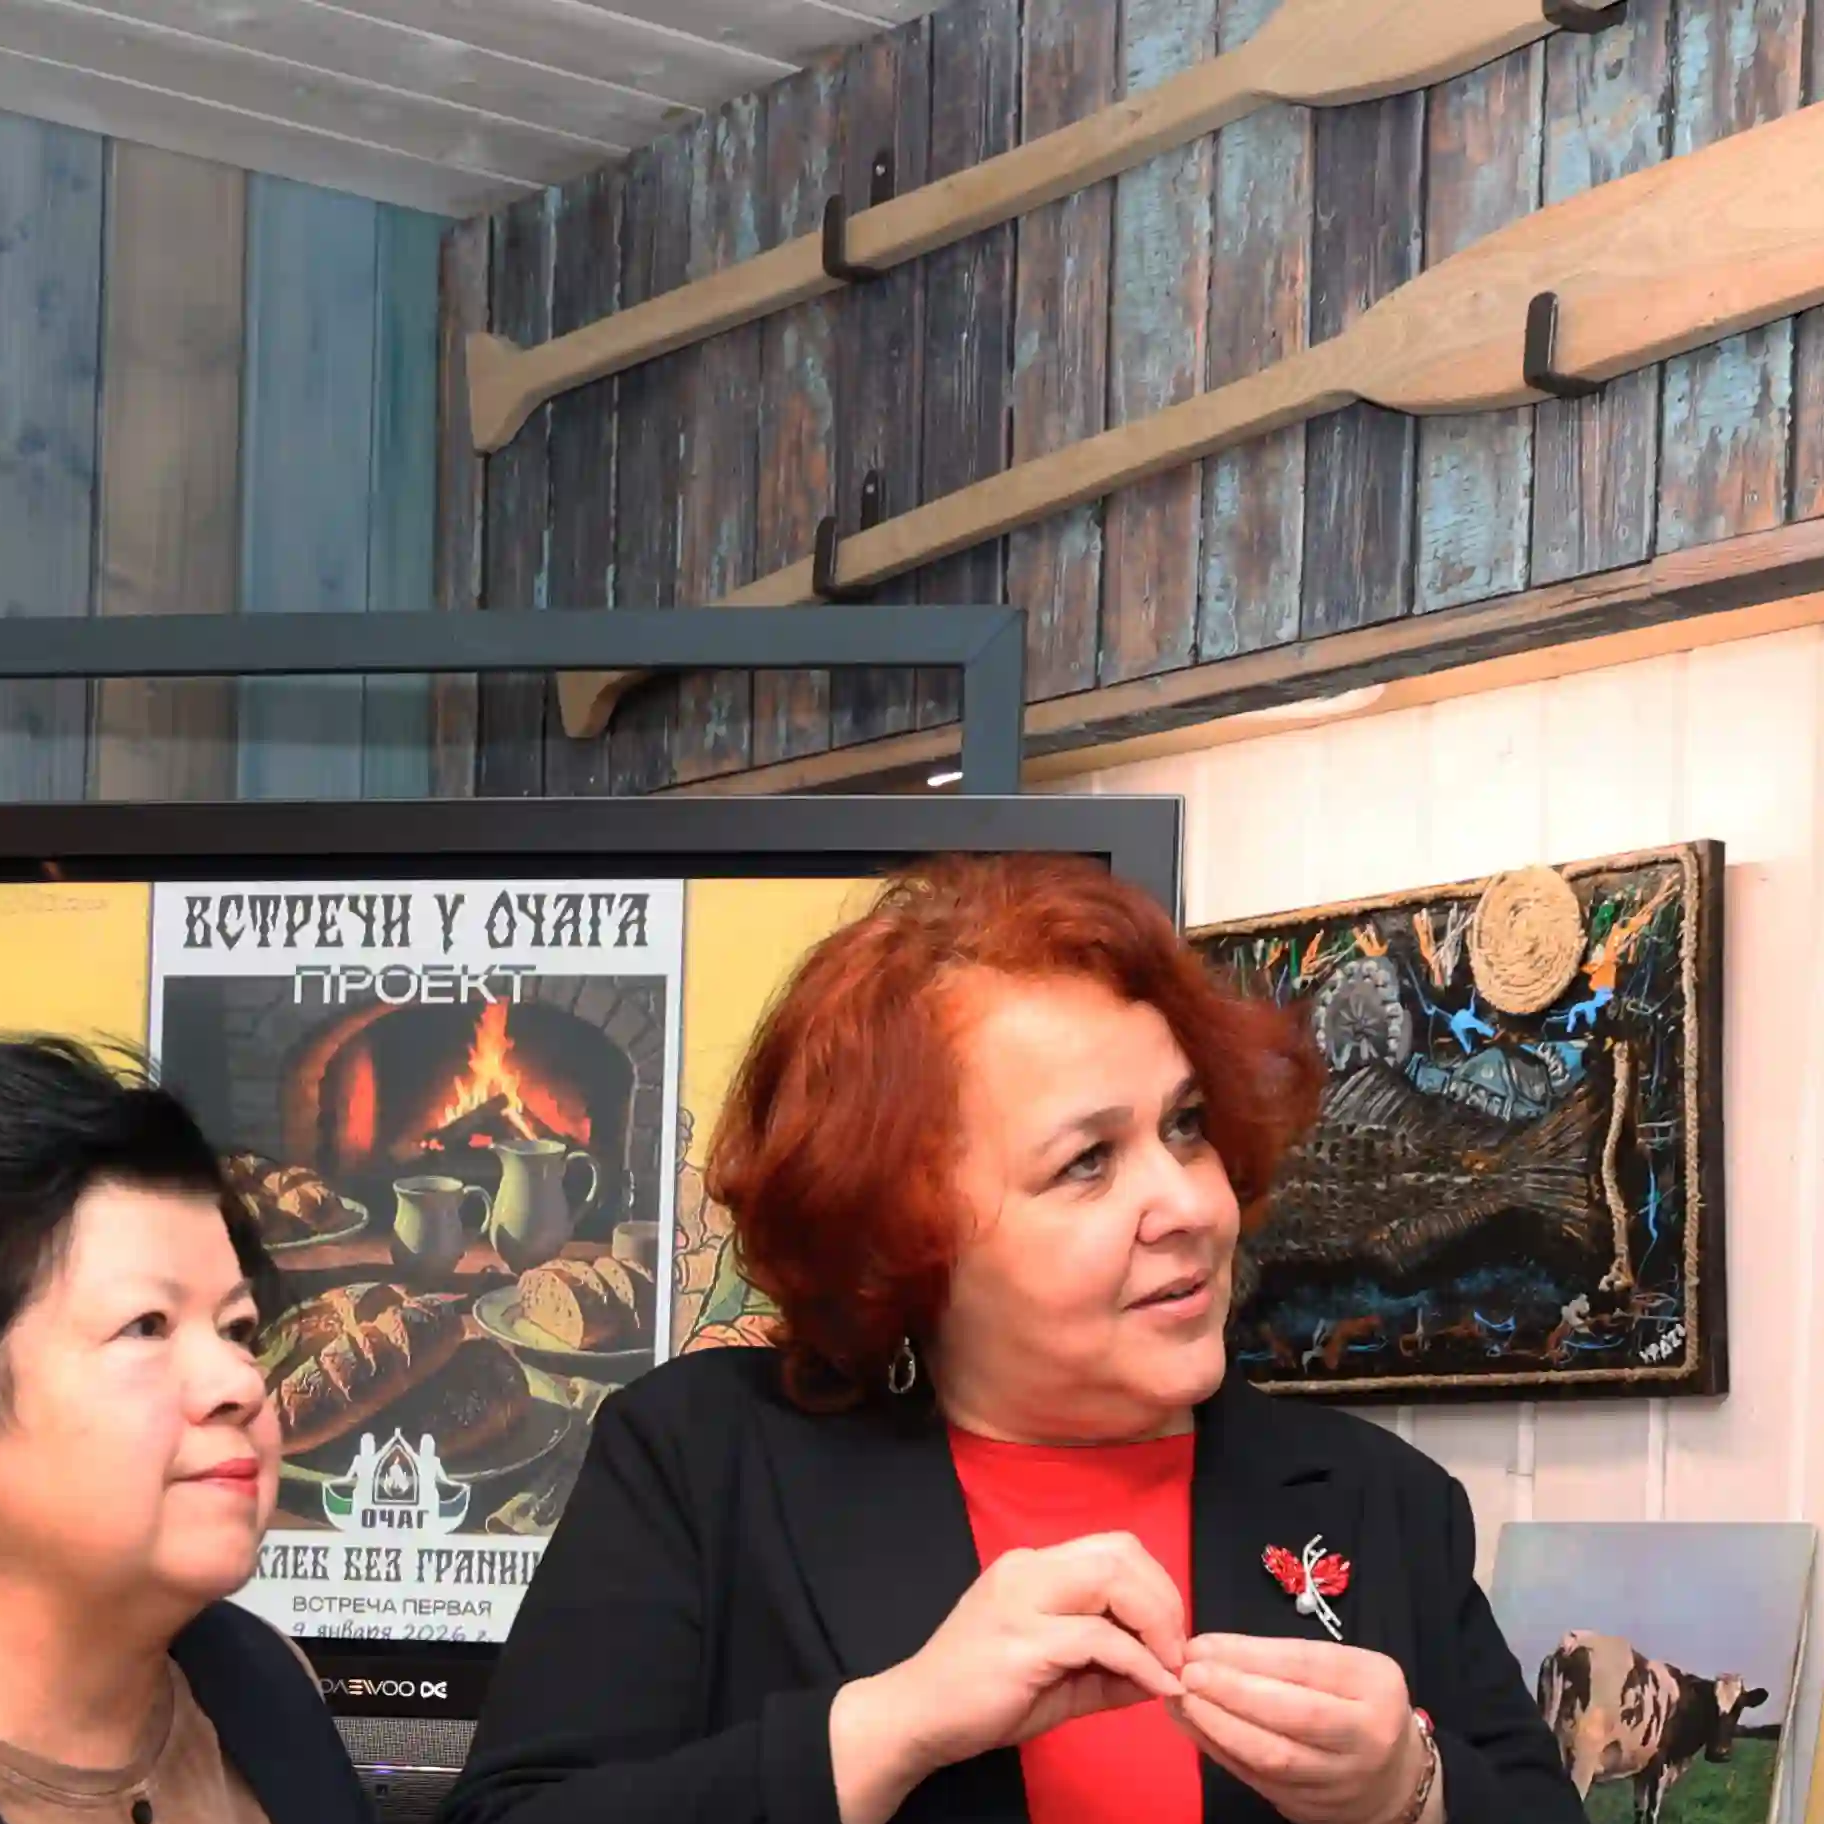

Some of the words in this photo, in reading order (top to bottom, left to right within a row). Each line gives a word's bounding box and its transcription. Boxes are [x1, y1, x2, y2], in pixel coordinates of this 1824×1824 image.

[182, 893, 412, 951] ВСТРЕЧИ
[434, 893, 465, 954] У
[484, 889, 650, 949] ОЧАГА
[292, 963, 537, 1005] ПРОЕКТ
[361, 1508, 429, 1529] ОЧАГ
[343, 1546, 402, 1582] БЕЗ
[292, 1596, 397, 1614] ВСТРЕЧА
[403, 1599, 492, 1618] ПЕРВАЯ
[292, 1621, 306, 1636] 9
[317, 1618, 393, 1640] января
[402, 1623, 466, 1642] 2026
[319, 1678, 415, 1697] DAEWOO
